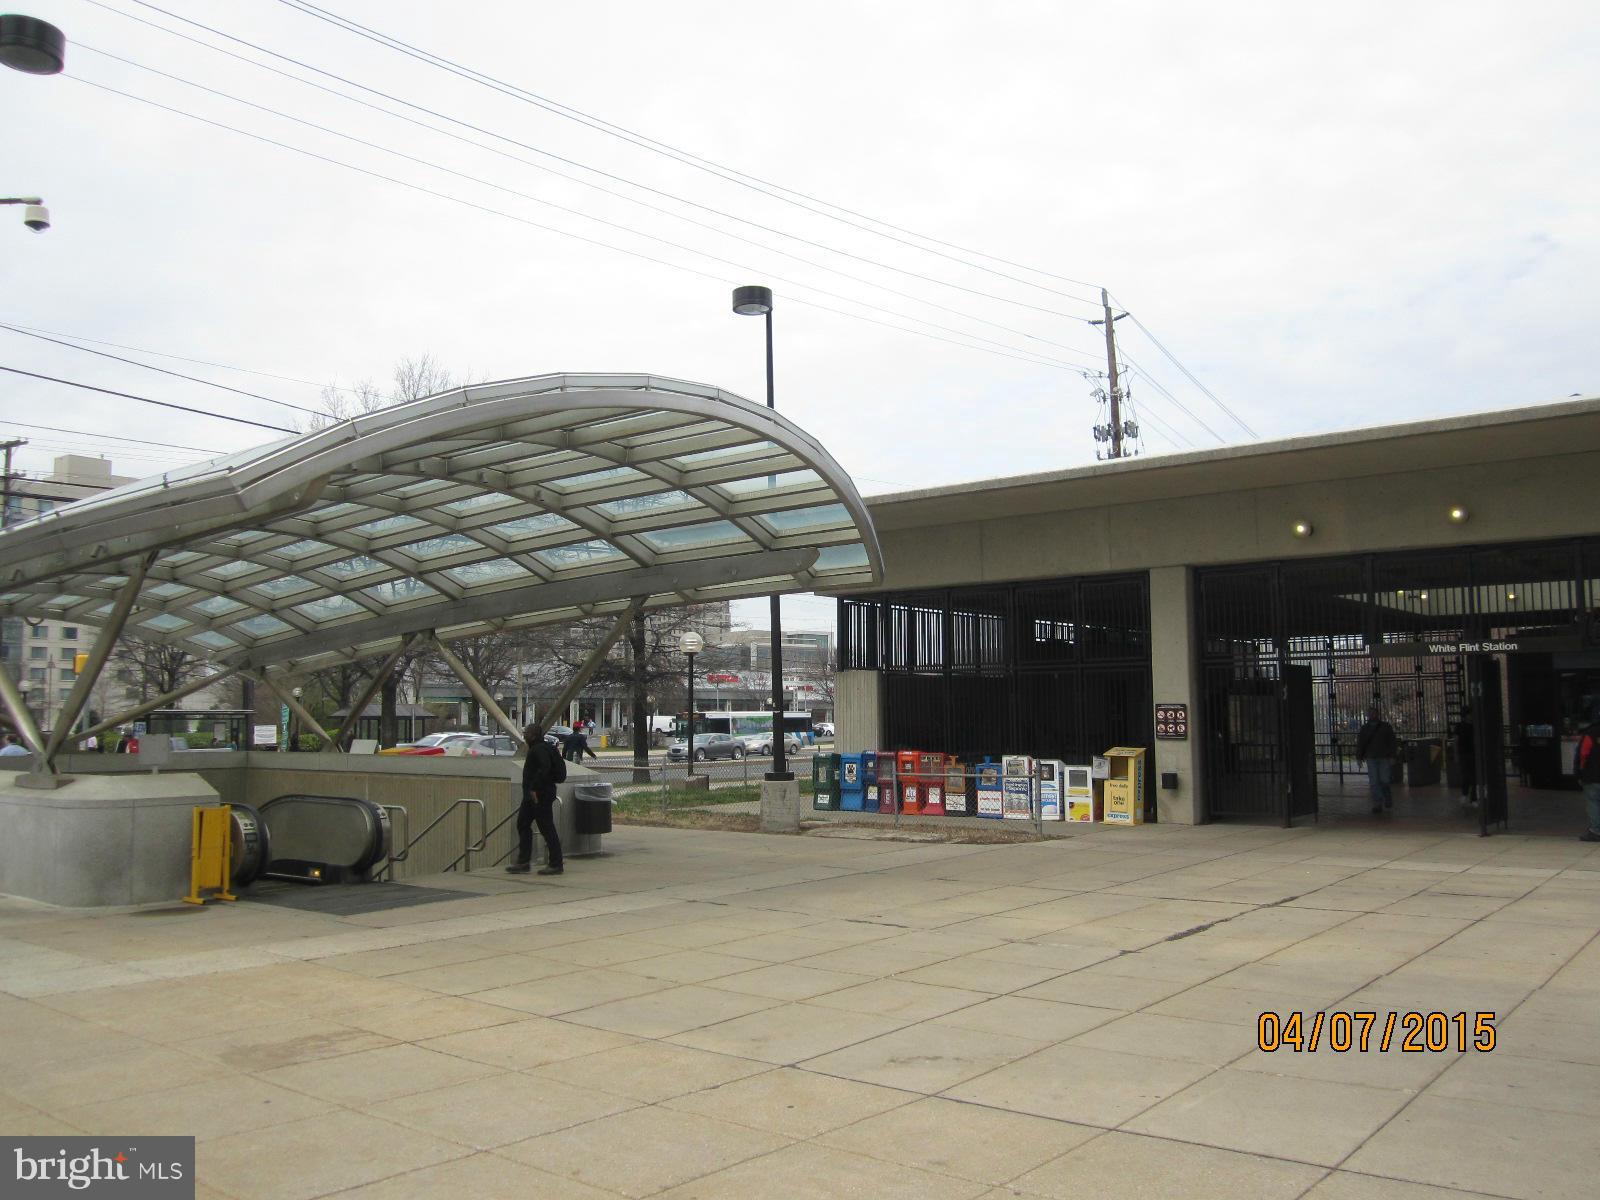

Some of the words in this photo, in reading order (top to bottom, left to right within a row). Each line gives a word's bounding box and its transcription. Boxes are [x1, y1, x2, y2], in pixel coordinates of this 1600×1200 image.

[1429, 643, 1457, 653] White
[1459, 643, 1480, 652] Flint
[1482, 641, 1518, 652] Station
